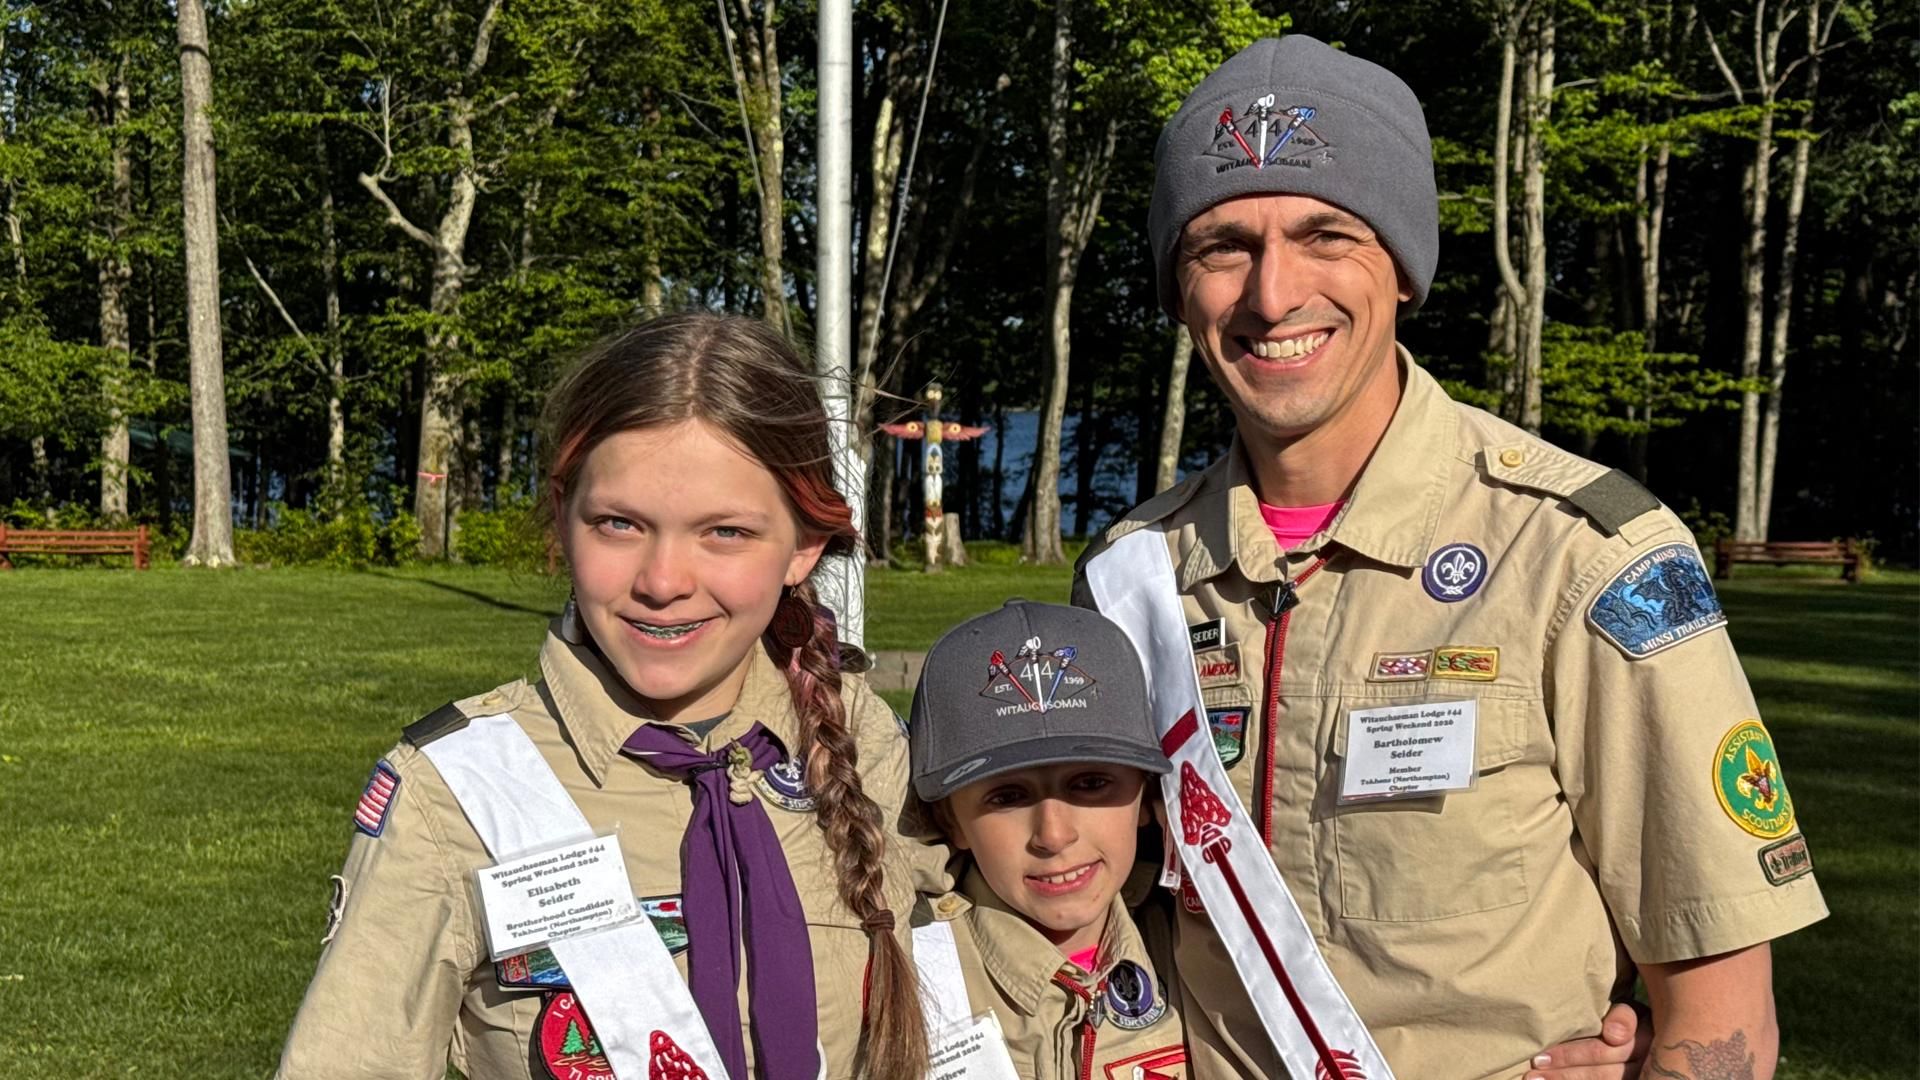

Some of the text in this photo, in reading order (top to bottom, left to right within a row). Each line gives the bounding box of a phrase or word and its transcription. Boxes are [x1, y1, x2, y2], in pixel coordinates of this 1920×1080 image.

[1625, 560, 1651, 584] CAMP
[1652, 548, 1678, 564] MINSI
[1192, 628, 1219, 643] SEIDER
[1640, 616, 1707, 652] MINSI TRAILS
[1200, 661, 1239, 677] AMERICA
[1420, 709, 1446, 718] Lodge
[1447, 708, 1463, 716] #44
[1366, 725, 1394, 734] Spring
[1395, 720, 1432, 730] Weekend
[1373, 736, 1444, 749] Bartholomew
[1390, 750, 1423, 759] Seider
[1389, 766, 1422, 774] Member
[491, 844, 605, 880] Witauchsoman Lodge #44
[501, 856, 599, 888] Spring Weekend 2026
[527, 877, 581, 898] Elisabeth
[538, 892, 575, 908] Seider
[506, 898, 615, 931] Brotherhood Candidate
[944, 1040, 969, 1052] Lodge
[928, 1051, 961, 1068] eekend
